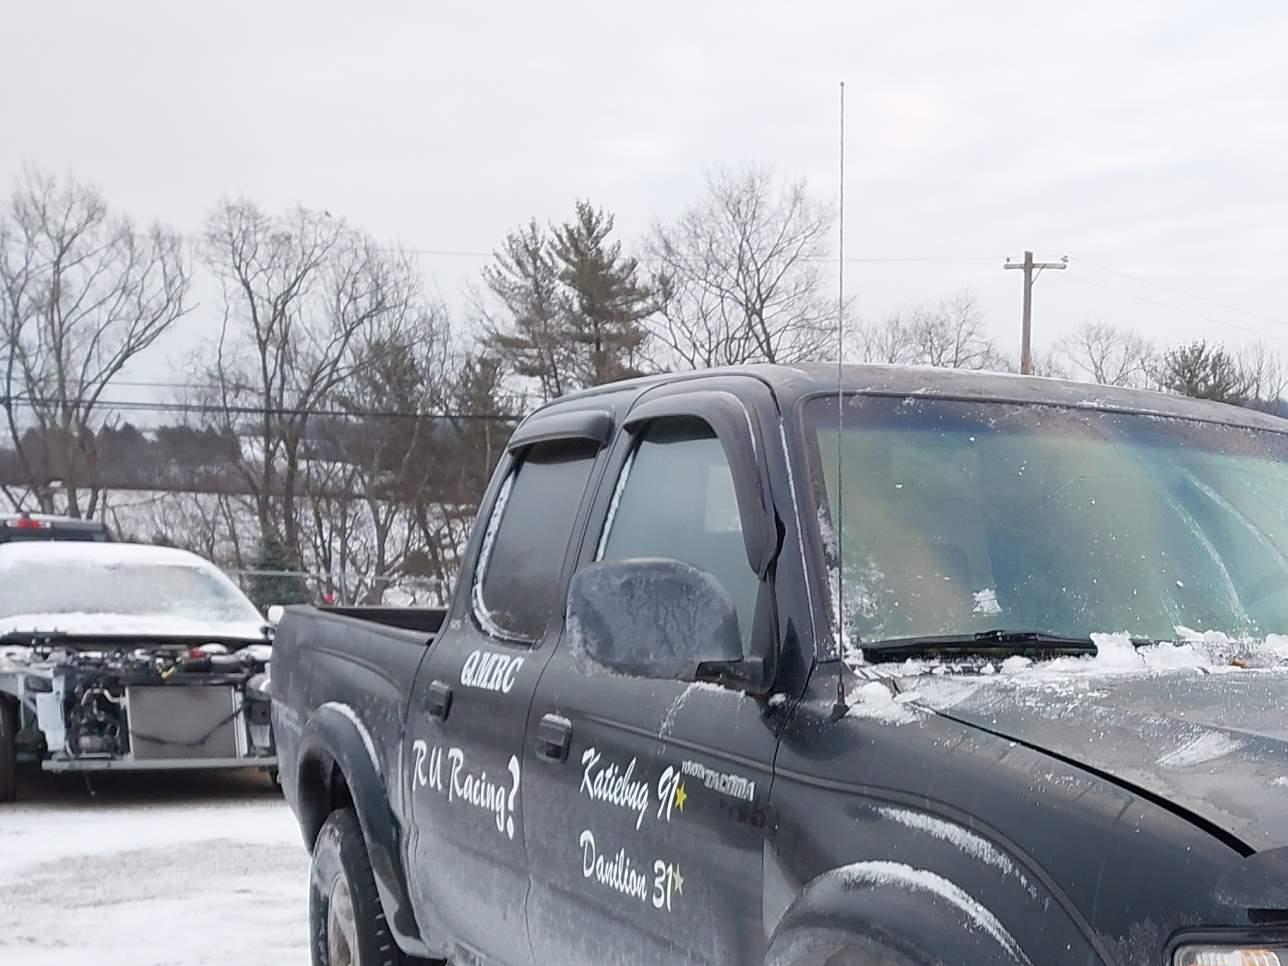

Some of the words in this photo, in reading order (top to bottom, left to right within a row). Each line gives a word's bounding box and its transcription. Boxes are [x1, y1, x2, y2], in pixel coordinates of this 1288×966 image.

[460, 649, 525, 694] QMRC
[412, 739, 443, 792] RU
[447, 747, 520, 840] Racing?
[579, 747, 649, 831] Katiebug
[657, 765, 681, 822] 91
[652, 859, 673, 913] 31
